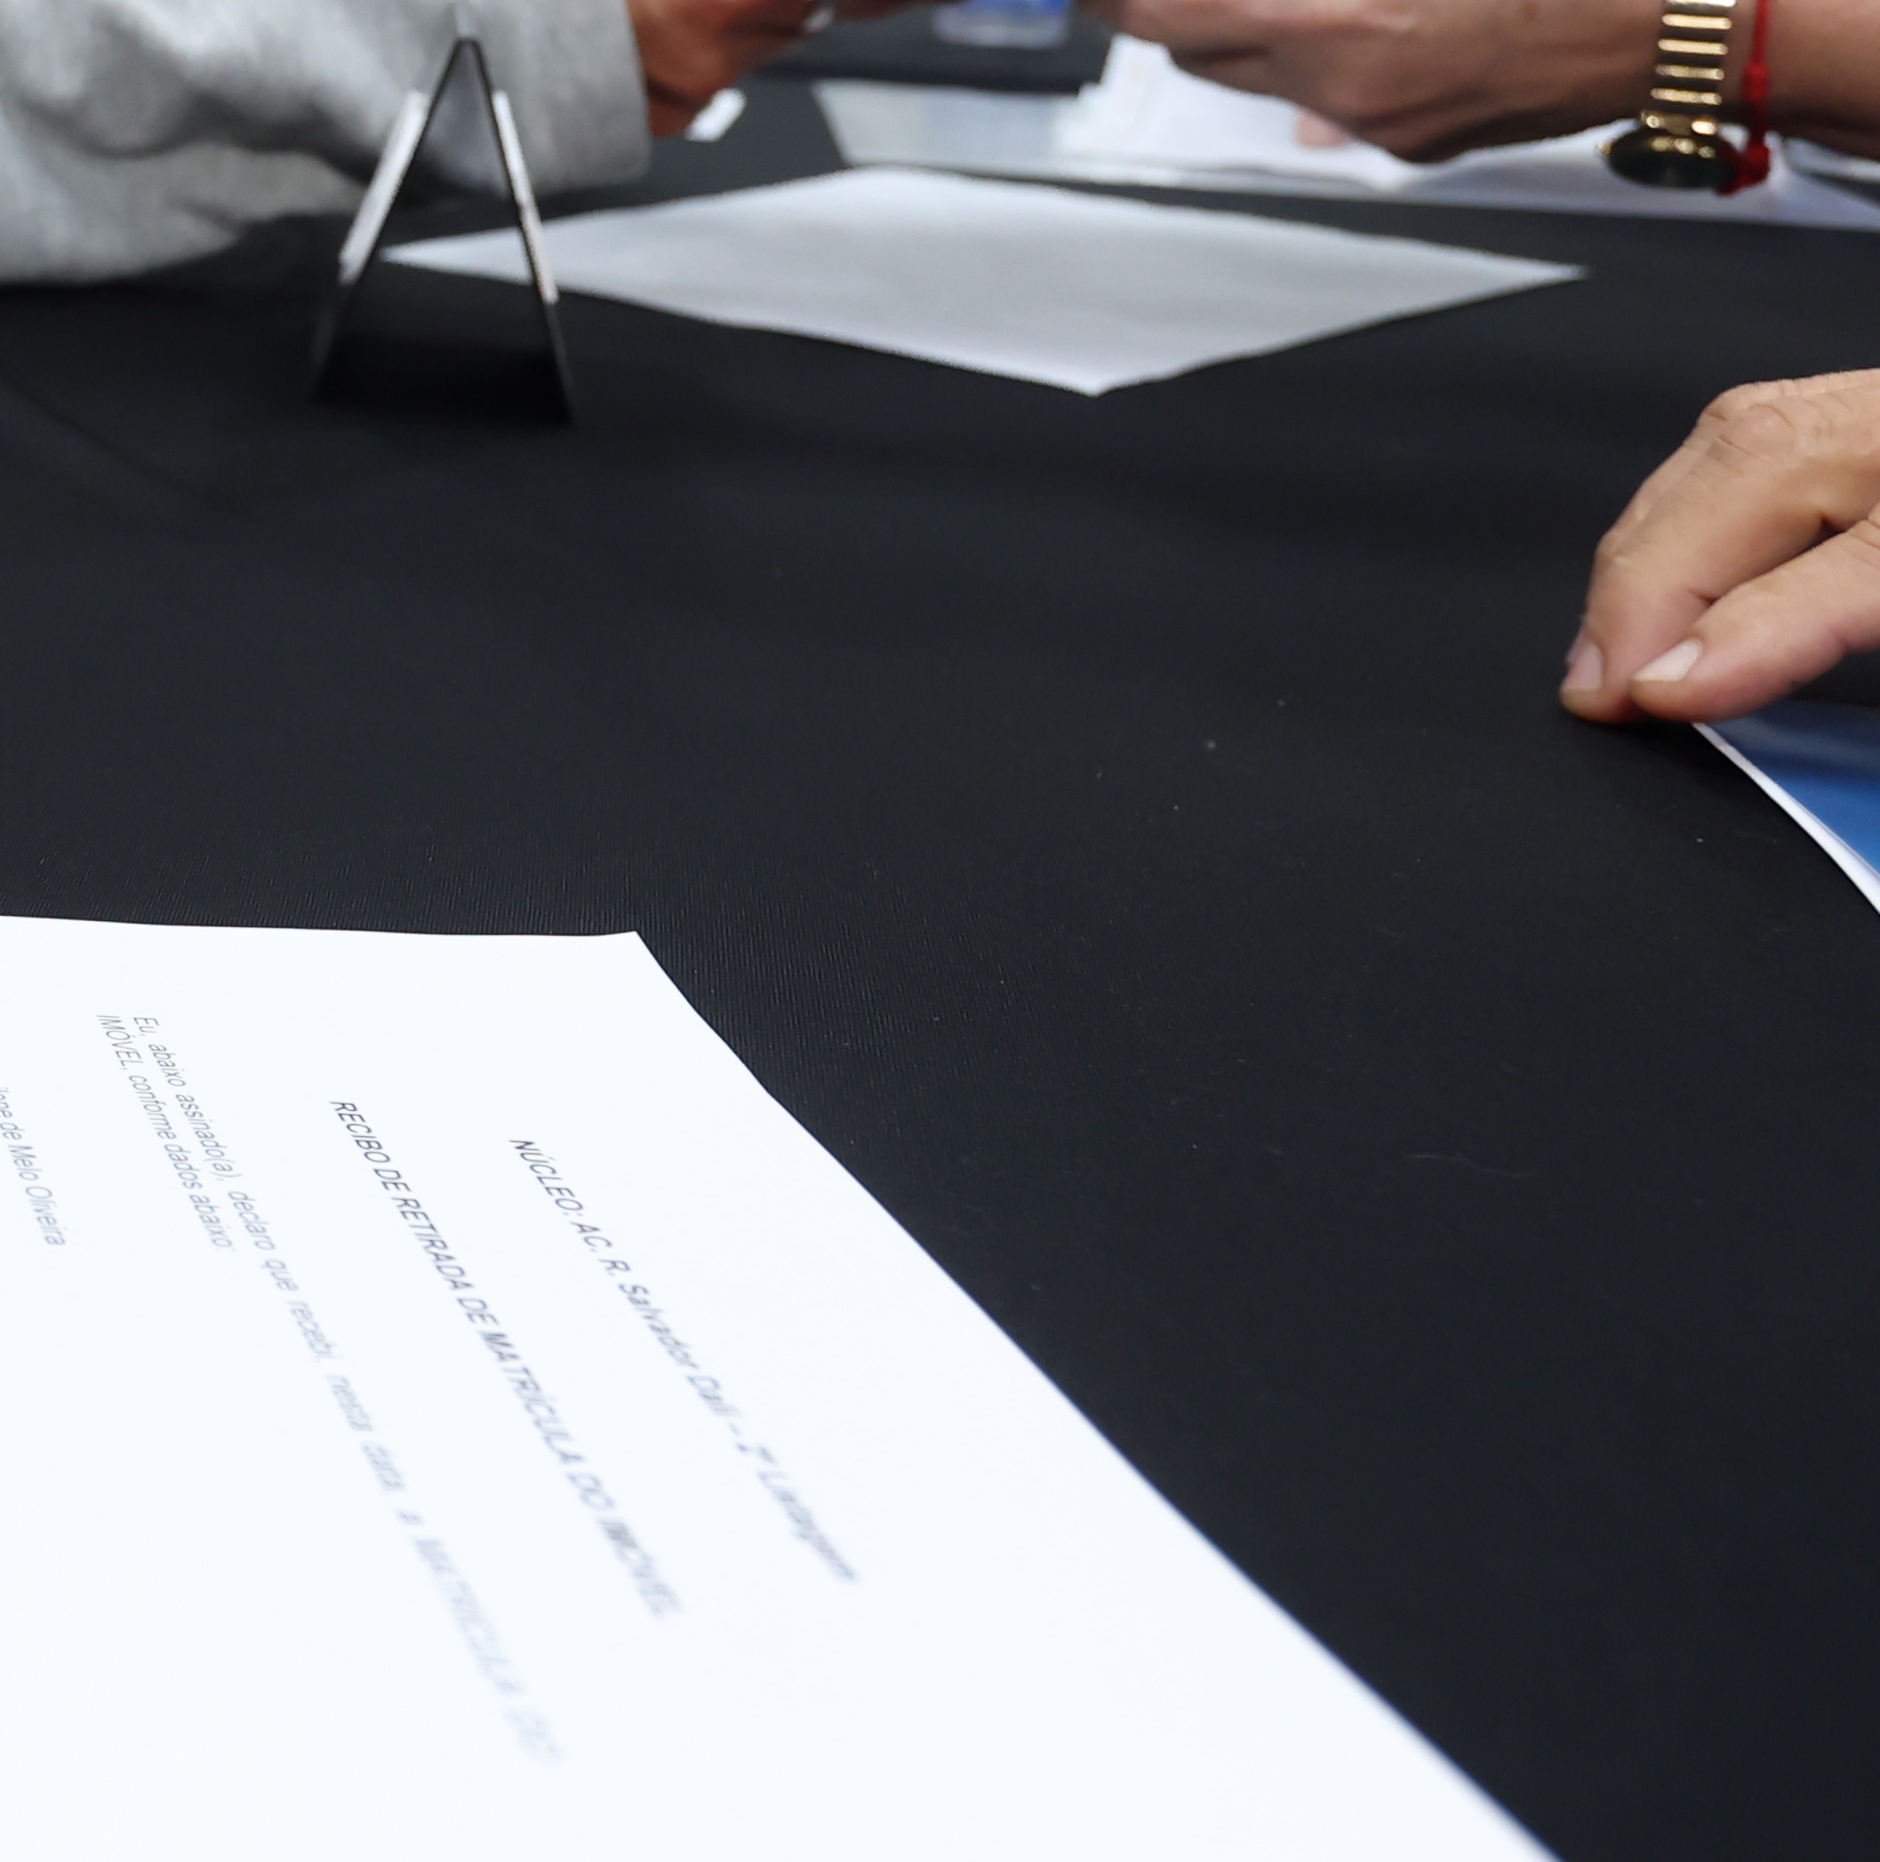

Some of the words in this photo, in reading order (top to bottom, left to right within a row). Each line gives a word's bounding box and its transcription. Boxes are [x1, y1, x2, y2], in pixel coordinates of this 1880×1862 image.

[0, 1122, 25, 1140] de
[8, 1144, 42, 1181] Melo
[128, 1075, 177, 1140] conforme
[163, 1144, 203, 1189] dados
[25, 1186, 66, 1245] Oliveira
[133, 1017, 160, 1036] Eu,
[148, 1044, 186, 1087] abaixo
[227, 1191, 276, 1250] declaro
[260, 1258, 299, 1292] que
[326, 1374, 375, 1432] nesta
[330, 1102, 391, 1163] RECIBO
[373, 1168, 411, 1192] DE
[392, 1197, 474, 1290] RETIRADA
[456, 1297, 499, 1325] DE
[509, 1140, 584, 1216] NÚCLEO:
[570, 1222, 612, 1252] AC.
[618, 1284, 700, 1370] Salvador
